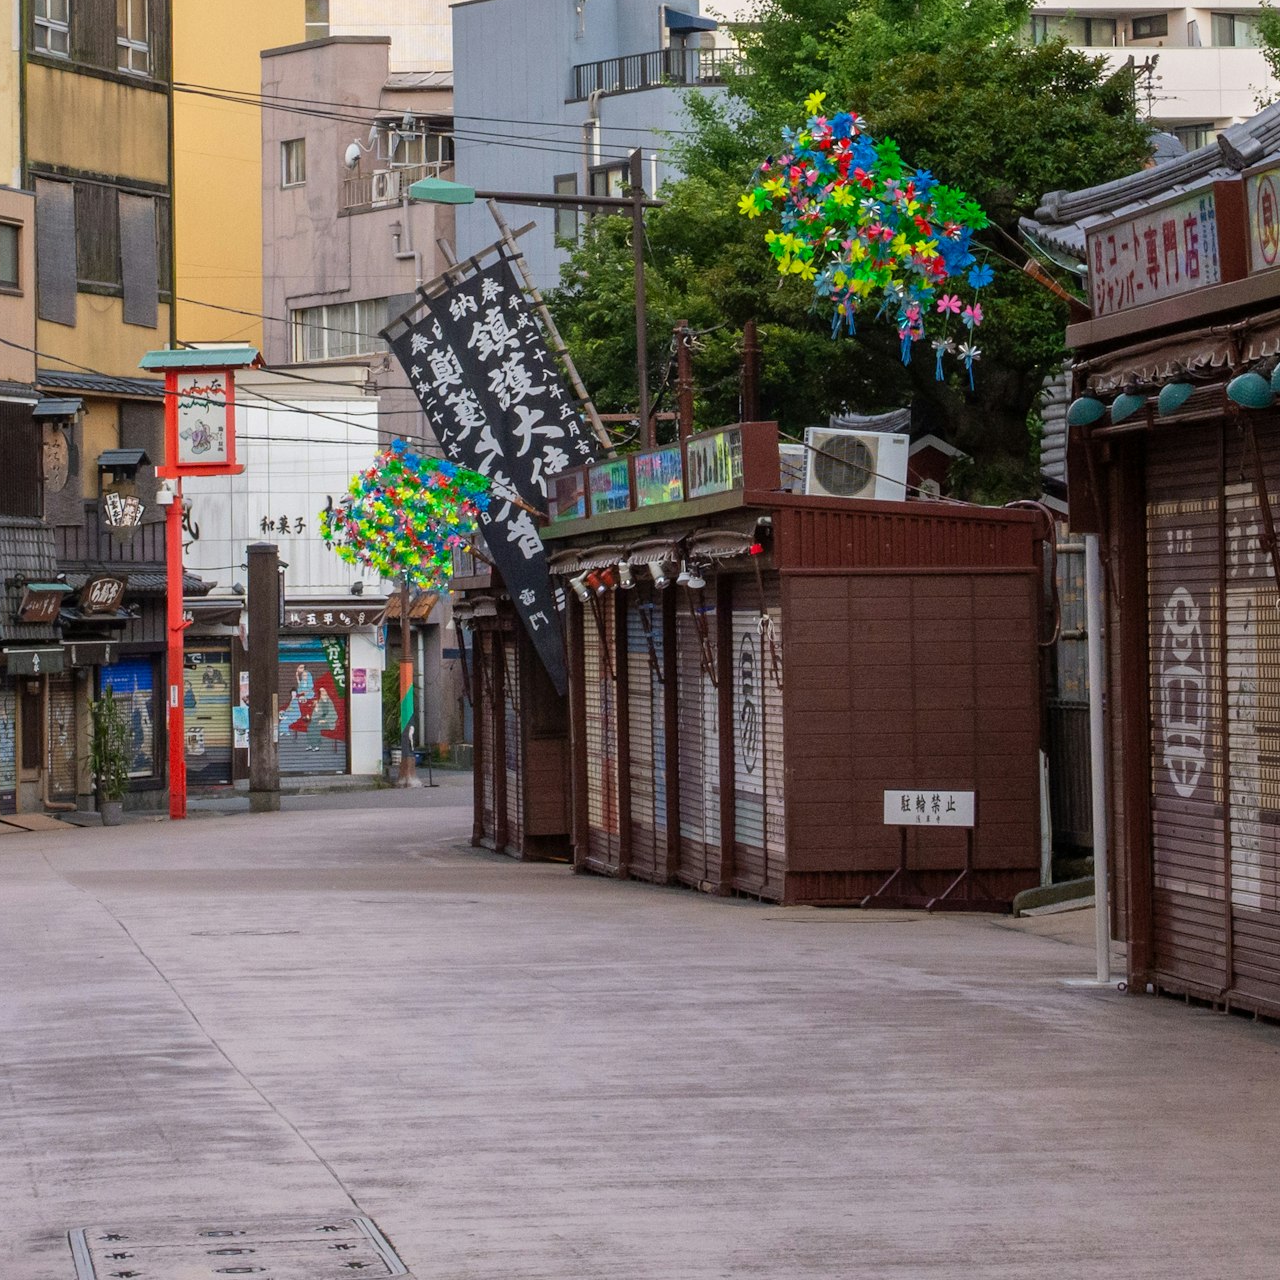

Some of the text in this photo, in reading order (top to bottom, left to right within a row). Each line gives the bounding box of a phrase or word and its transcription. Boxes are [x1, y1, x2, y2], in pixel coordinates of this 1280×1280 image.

[1144, 212, 1200, 290] 専門店
[449, 277, 505, 322] 奉納
[259, 514, 307, 536] 和菓子
[900, 793, 957, 814] 駐輪禁止
